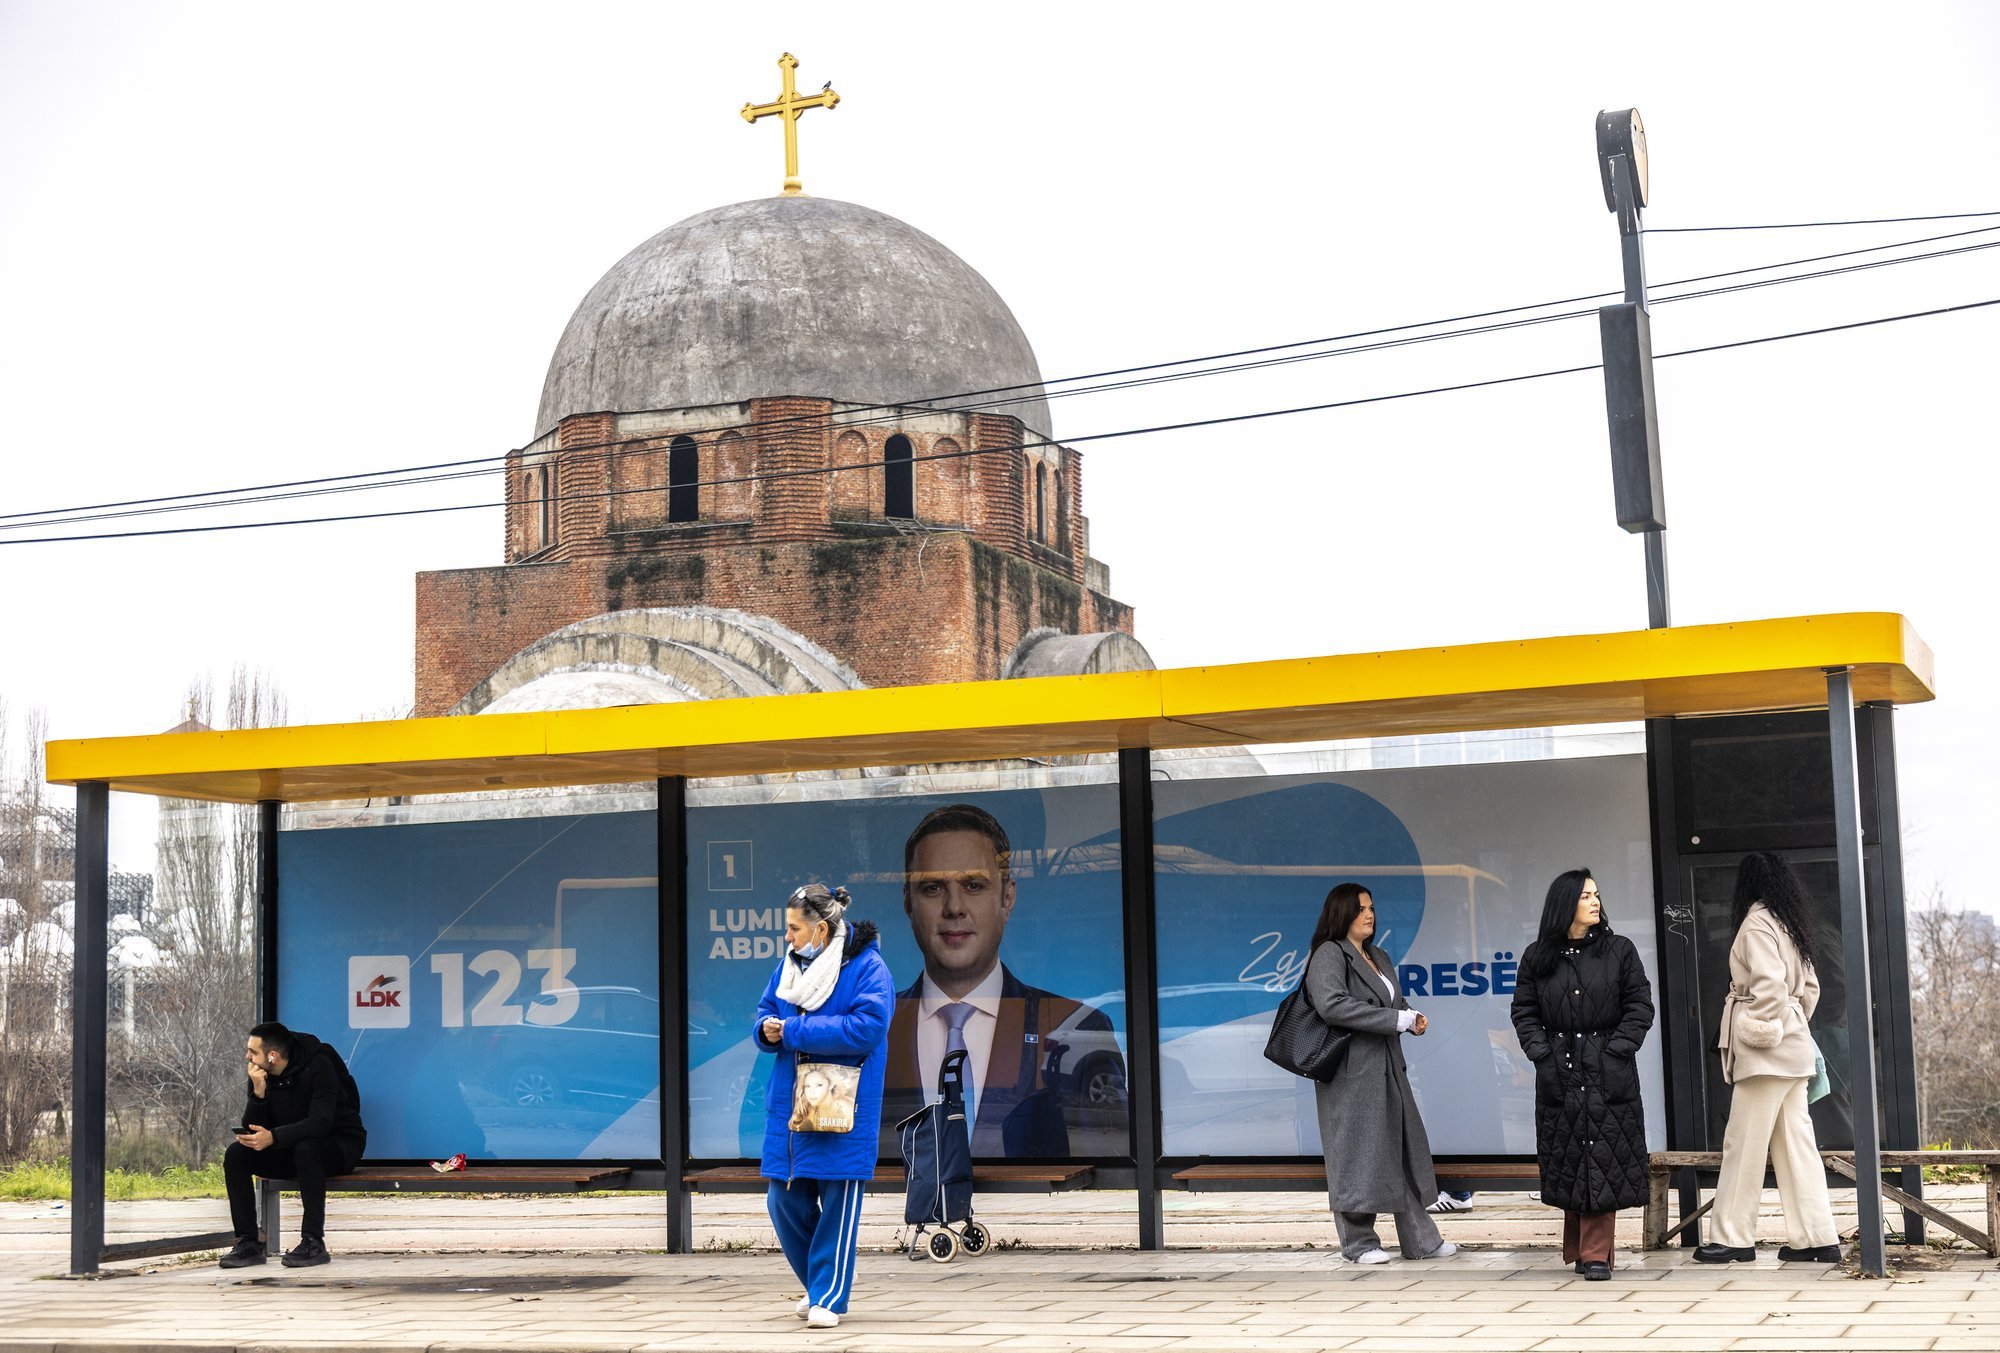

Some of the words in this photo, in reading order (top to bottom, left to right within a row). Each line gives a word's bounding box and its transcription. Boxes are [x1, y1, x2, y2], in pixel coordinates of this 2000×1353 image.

[723, 854, 735, 878] 1
[709, 907, 788, 932] LUMI
[356, 991, 402, 1008] LDK
[430, 948, 580, 1028] 123
